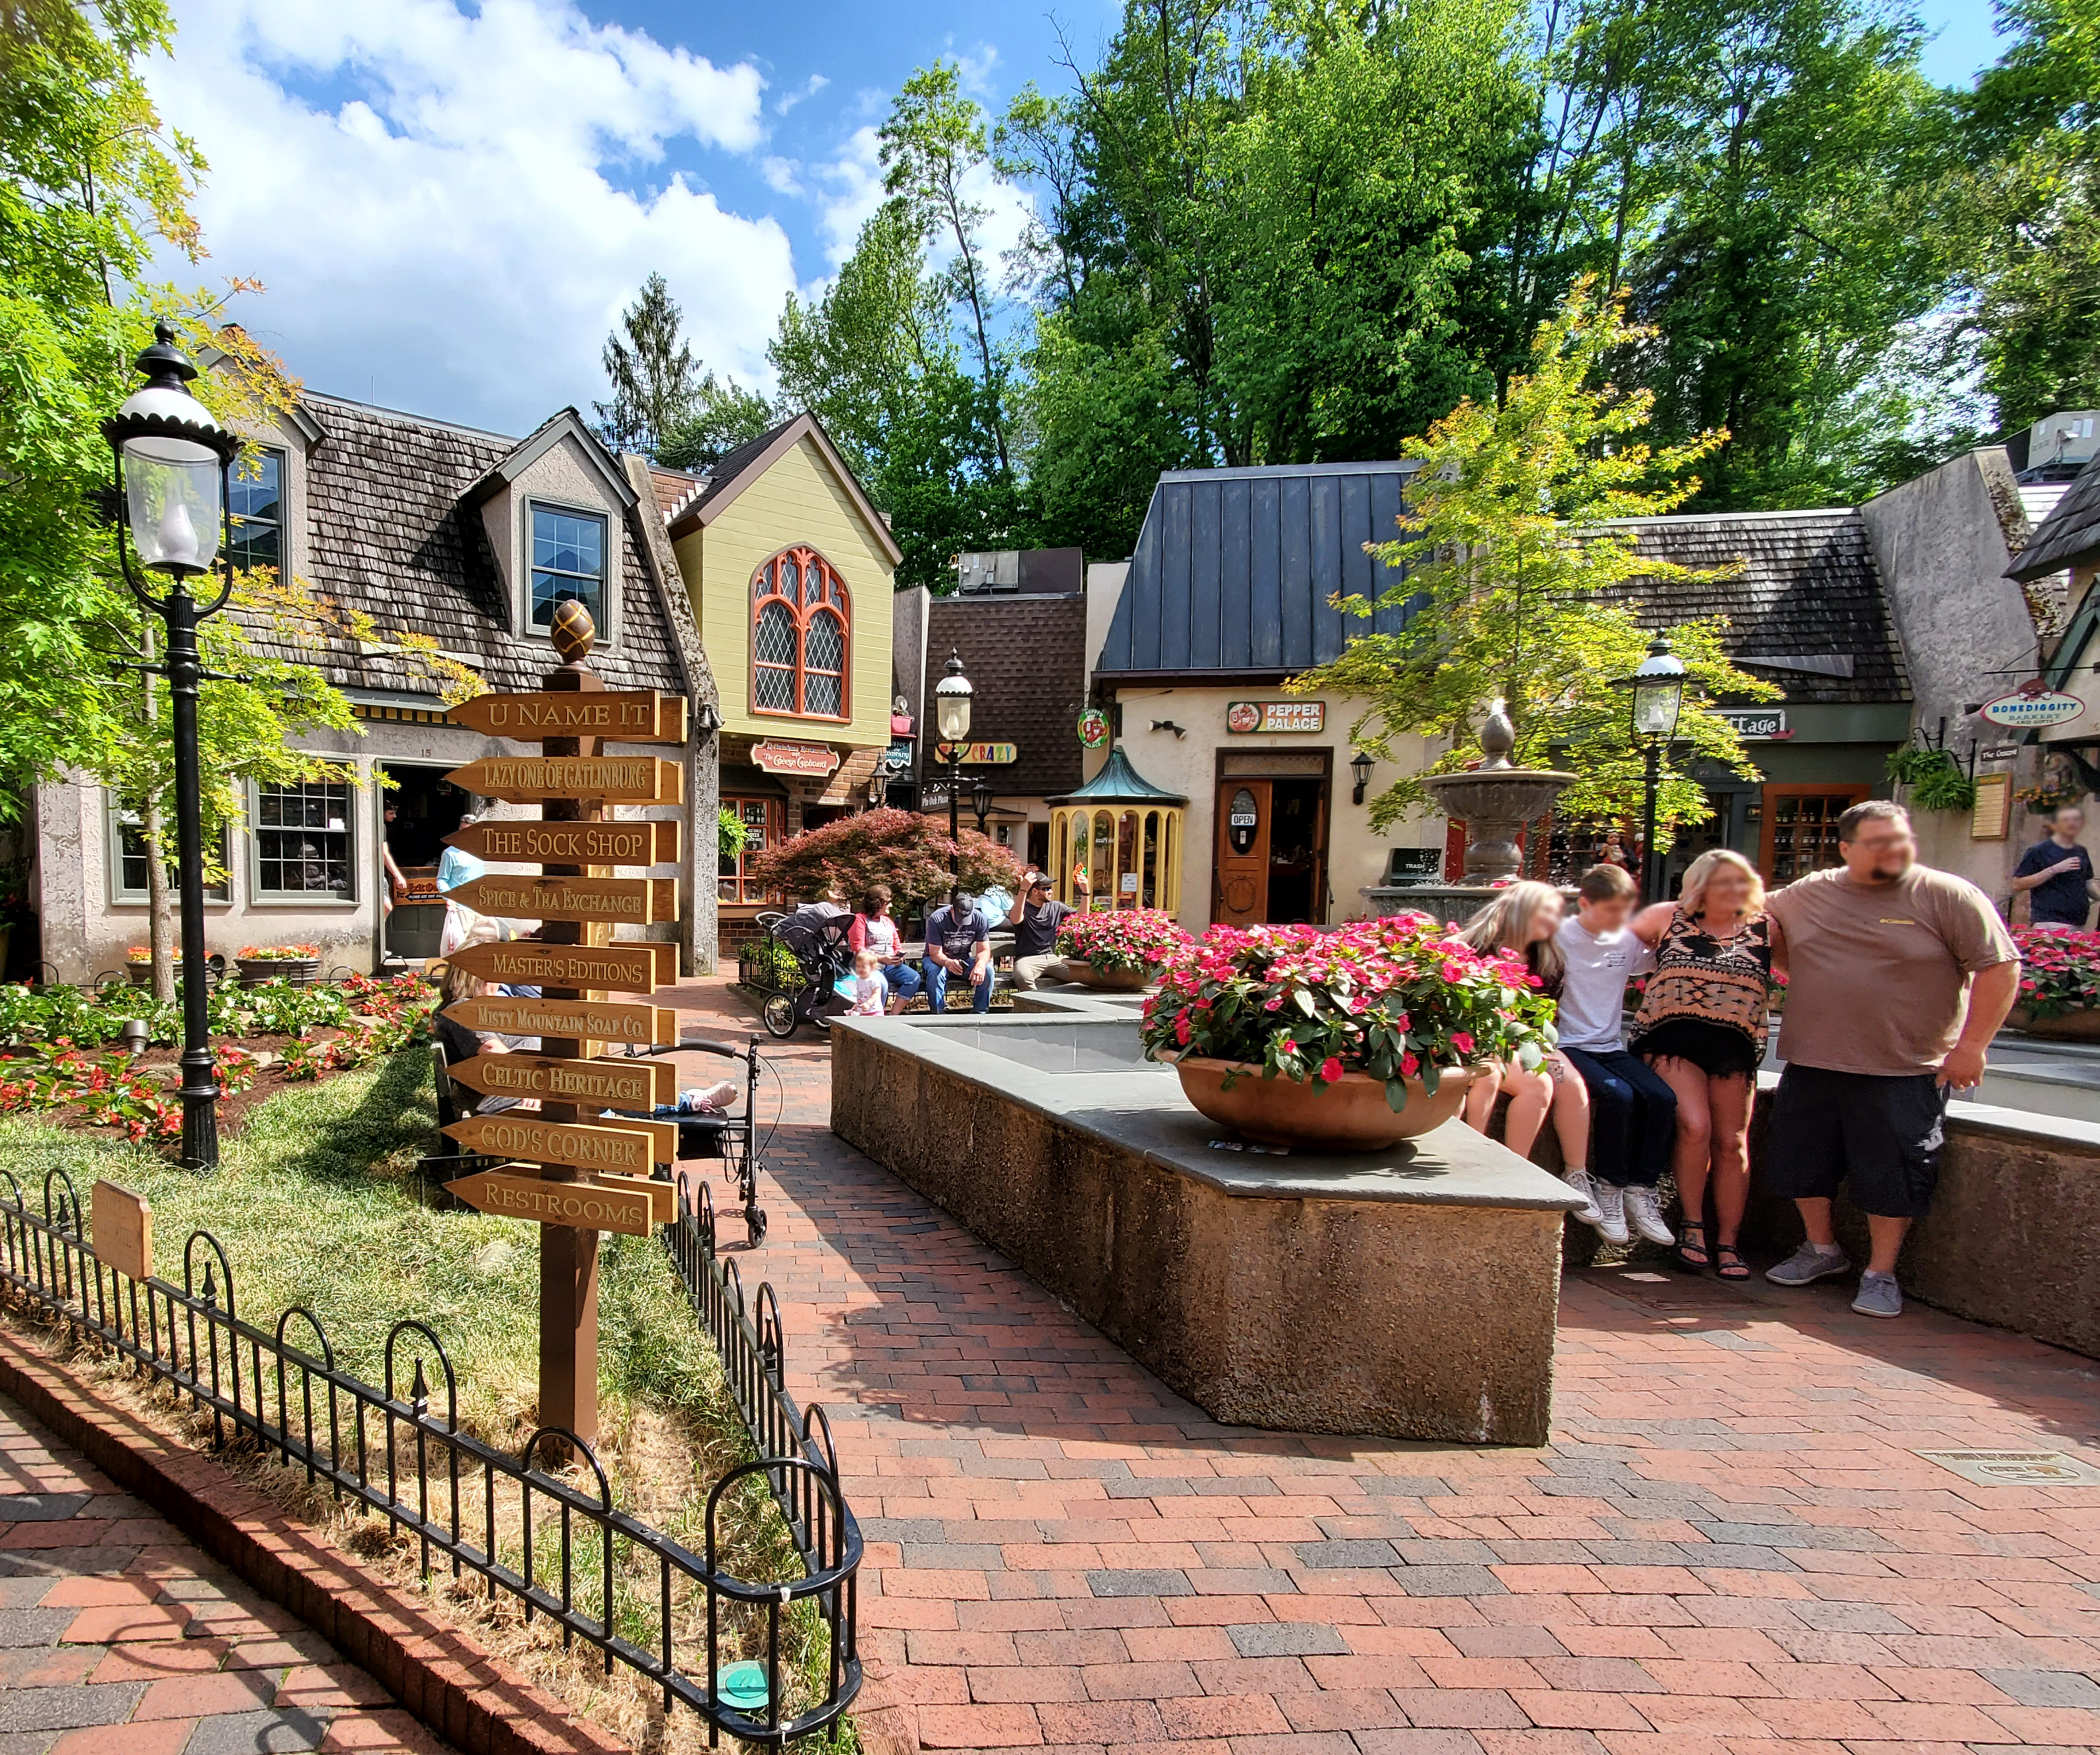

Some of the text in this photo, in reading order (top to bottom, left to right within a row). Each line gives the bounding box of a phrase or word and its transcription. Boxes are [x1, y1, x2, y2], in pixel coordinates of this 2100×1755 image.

[487, 701, 650, 726] U NAME IT
[1085, 709, 1103, 718] PEPPER
[1267, 704, 1320, 716] PEPPER
[1992, 703, 2077, 713] BONEDIGGITY
[1267, 718, 1319, 730] PALACE
[1729, 716, 1776, 734] ttage
[422, 748, 431, 758] 15
[763, 753, 827, 768] The Cheese Cupboard
[972, 745, 1012, 762] CRAZY
[485, 763, 646, 789] LAZY ONE OF GATLINBURG
[1234, 815, 1253, 824] OPEN
[482, 829, 643, 857] THE SOCK SHOP
[479, 885, 641, 914] SPICE & TEA EXCHANGE
[493, 953, 643, 984] MASTER'S EDITIONS
[477, 1005, 645, 1037] MISTY MOUNTAIN SOAP CO.
[482, 1062, 643, 1100] CELTIC HERITAGE
[481, 1124, 637, 1166] GOD'S CORNER
[485, 1183, 644, 1226] RESTROOMS
